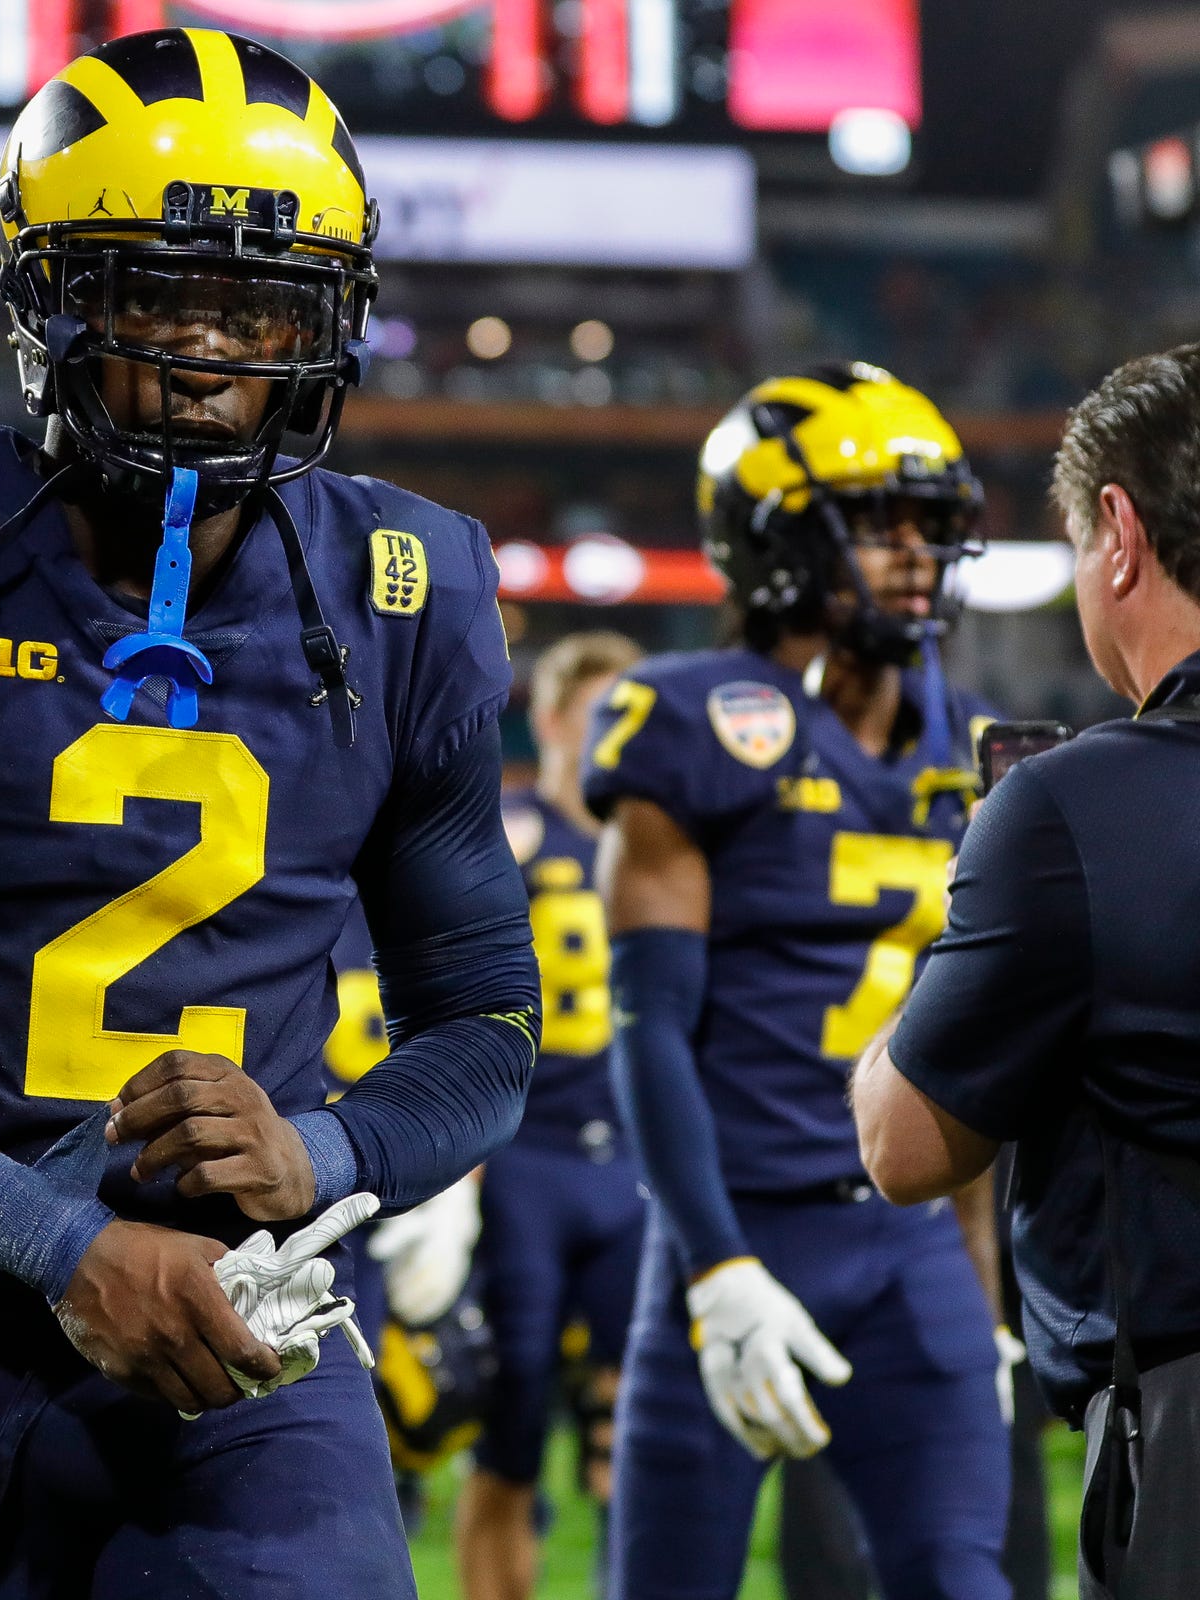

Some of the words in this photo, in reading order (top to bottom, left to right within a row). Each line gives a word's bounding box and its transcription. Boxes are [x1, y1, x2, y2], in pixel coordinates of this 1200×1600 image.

[209, 187, 250, 216] M
[382, 534, 414, 558] TM
[385, 556, 418, 583] 42
[593, 680, 657, 769] 7
[24, 723, 270, 1102] 2
[820, 831, 954, 1060] 7
